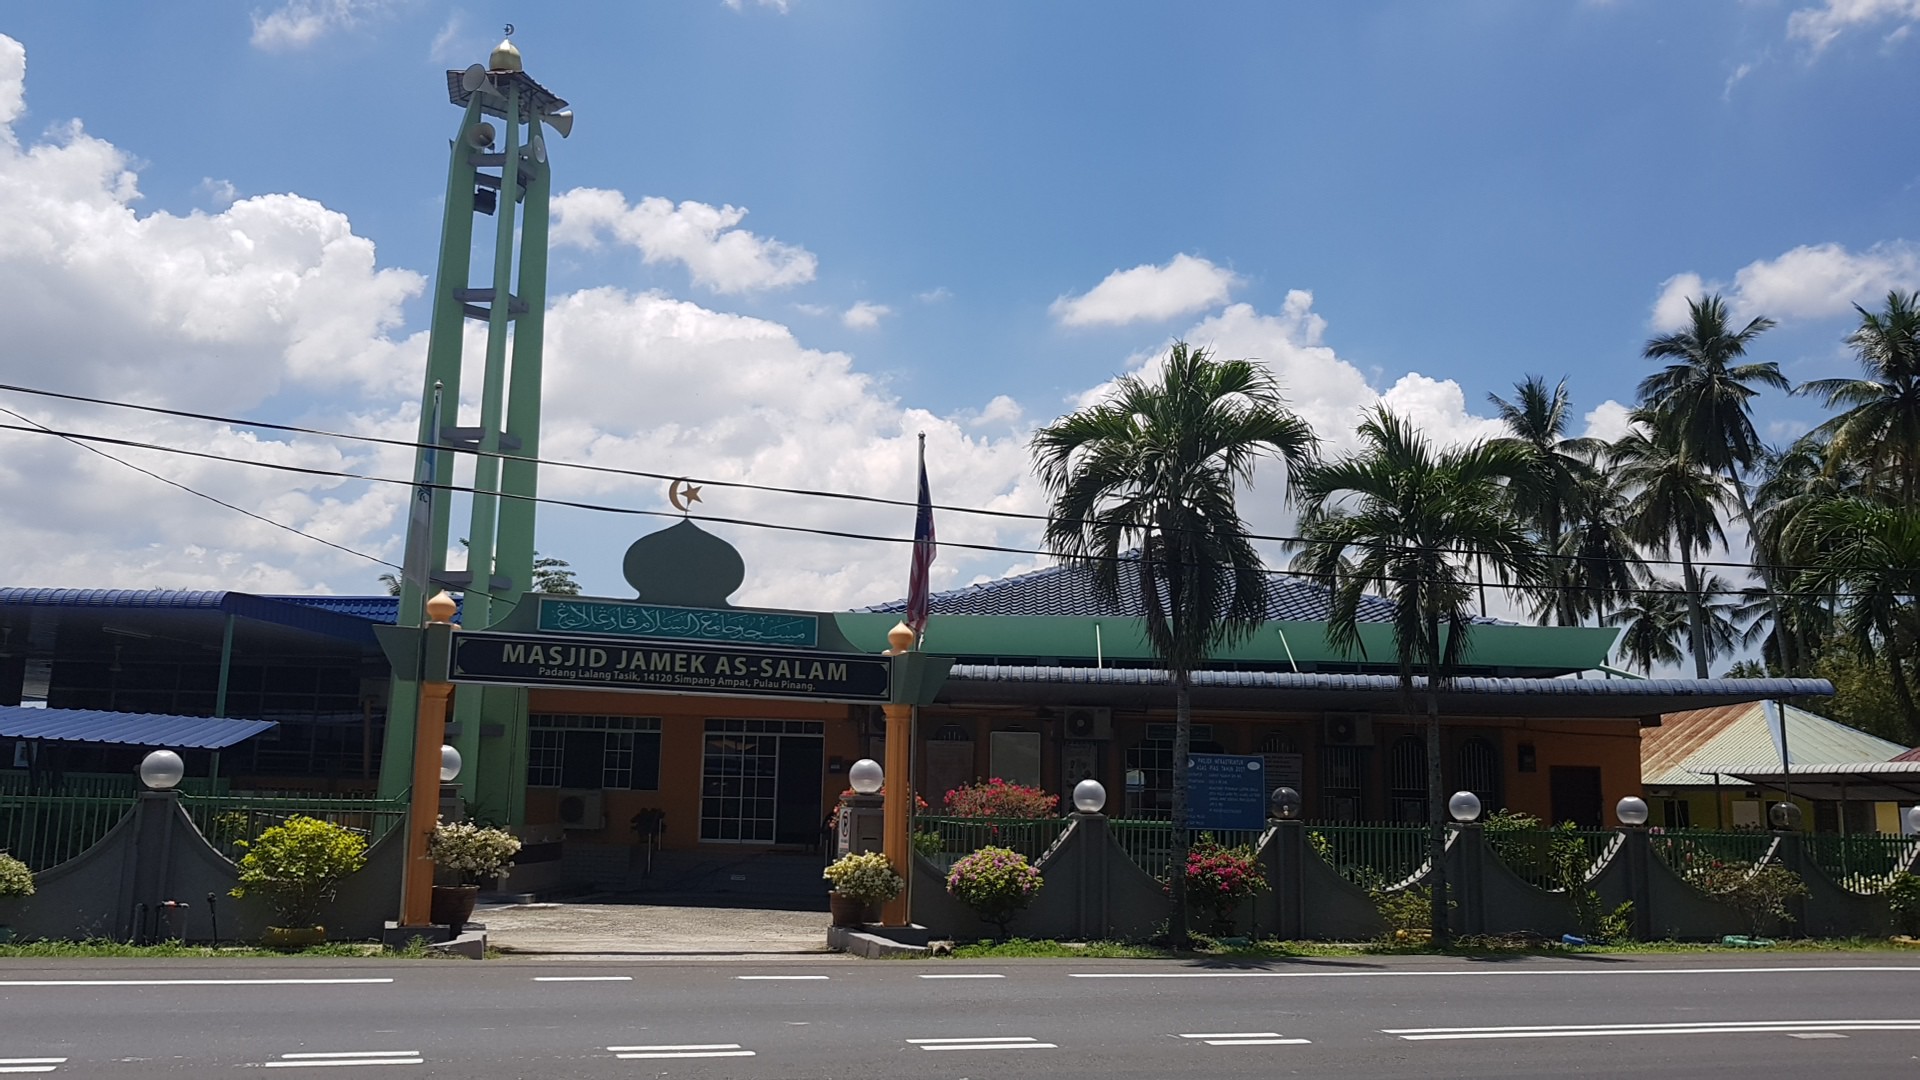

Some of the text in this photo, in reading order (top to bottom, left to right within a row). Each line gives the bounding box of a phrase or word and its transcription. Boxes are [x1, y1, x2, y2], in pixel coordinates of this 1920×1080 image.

[502, 643, 847, 681] MASJID JAMEK AS-SALAM
[538, 667, 816, 692] Padang Lalang Tasik, 14120 Simpang Ampat, Pulau Pinang.
